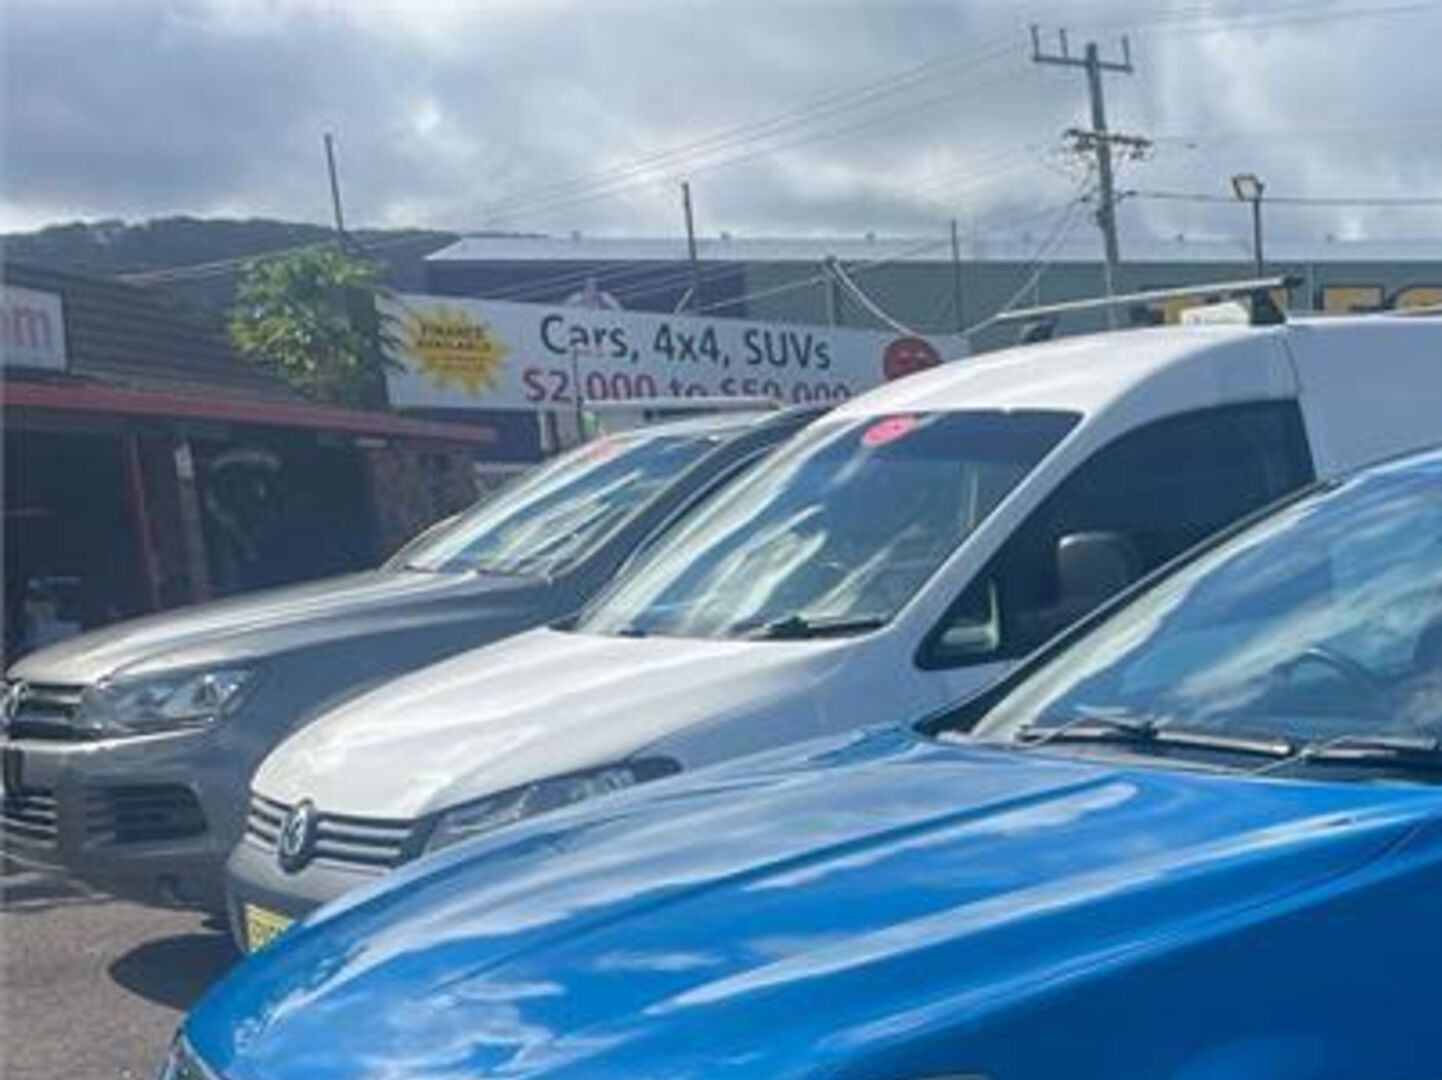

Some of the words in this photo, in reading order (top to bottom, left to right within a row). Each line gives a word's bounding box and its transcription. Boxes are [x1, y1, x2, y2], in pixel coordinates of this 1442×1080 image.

[540, 313, 640, 363] Cars,
[653, 323, 730, 369] 4x4,
[744, 328, 831, 370] SUVs
